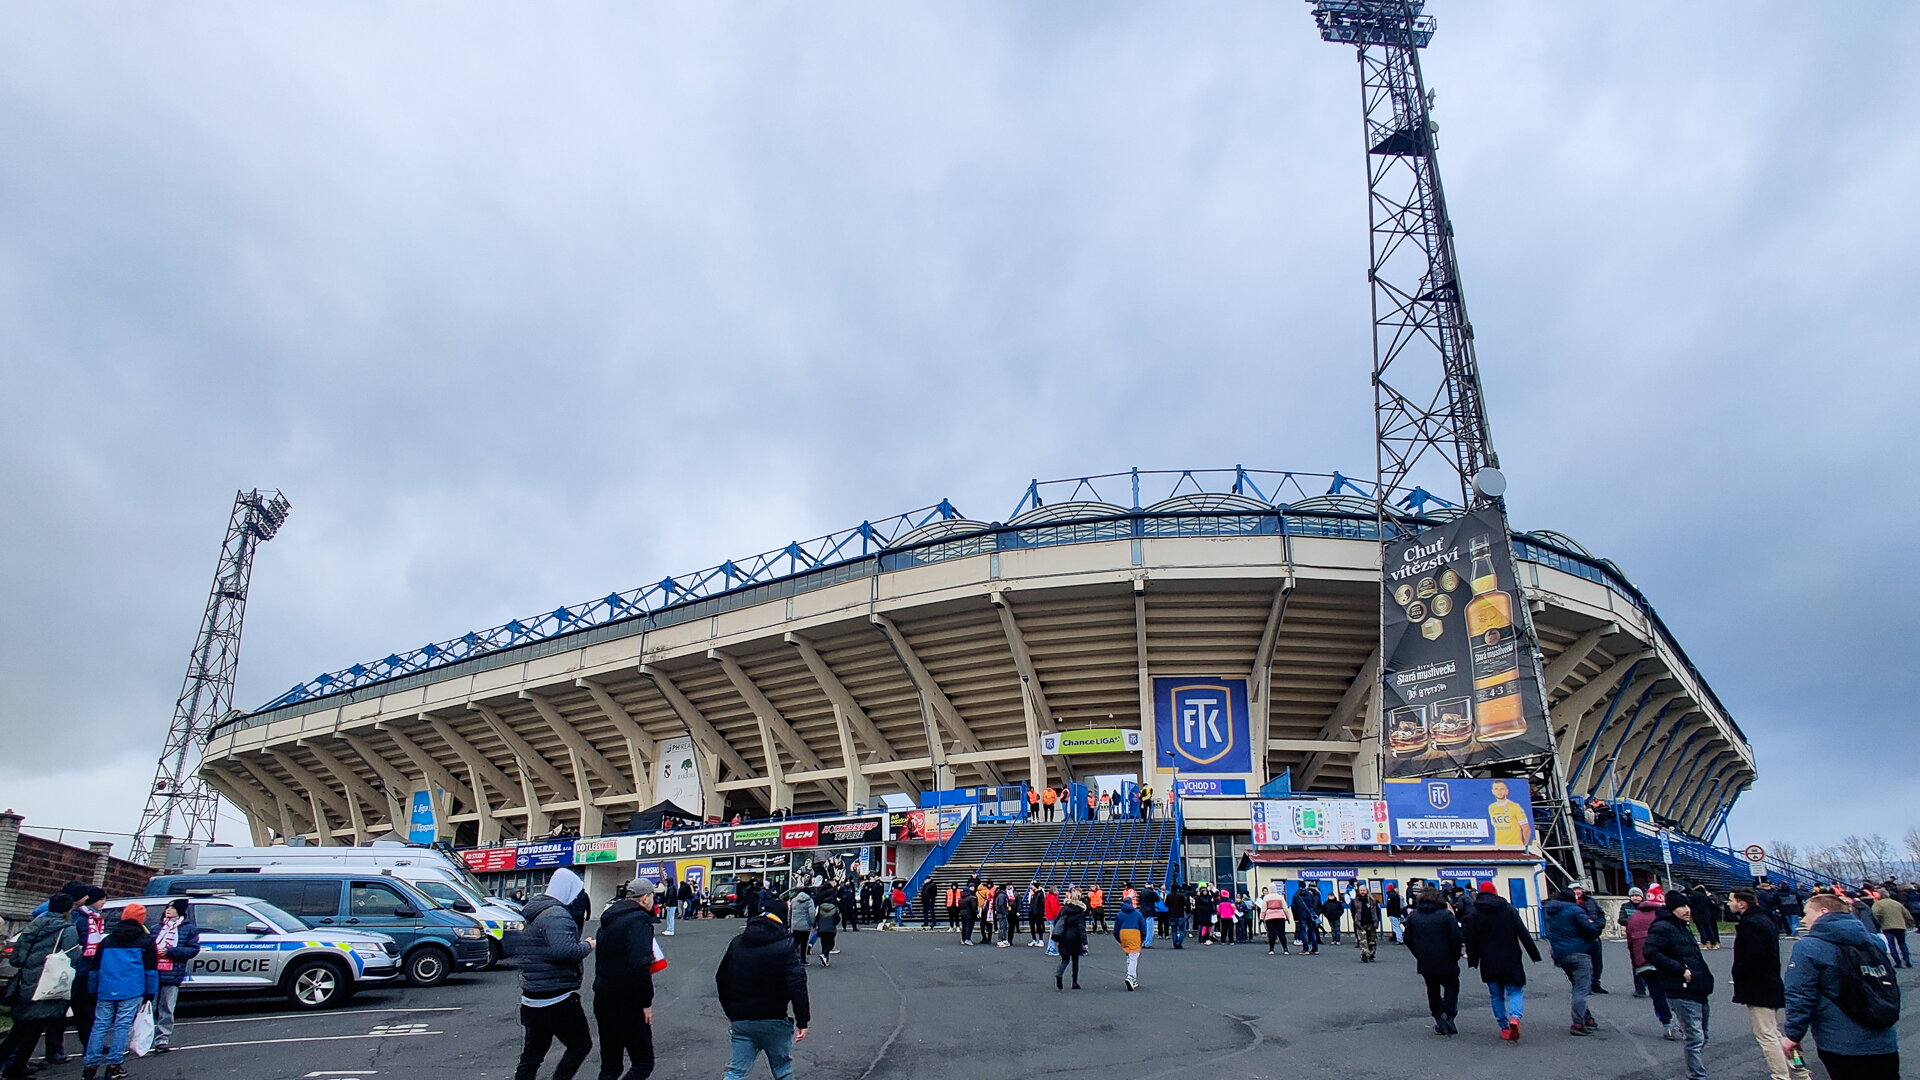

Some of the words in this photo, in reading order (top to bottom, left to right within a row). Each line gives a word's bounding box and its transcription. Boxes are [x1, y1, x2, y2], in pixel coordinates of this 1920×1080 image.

[1403, 537, 1445, 562] Chuť
[1390, 546, 1460, 581] vítězství
[1396, 672, 1416, 685] Stará
[1416, 662, 1456, 680] myslivecká
[1183, 781, 1209, 790] VCHOD
[1210, 781, 1217, 790] D
[1407, 821, 1418, 829] SK
[1419, 821, 1448, 829] SLAVIA
[1450, 821, 1478, 829] PRAHA
[784, 830, 815, 840] CCM
[517, 844, 562, 855] KOVOSREAL
[638, 832, 732, 856] FOTBAL-SPORT
[640, 866, 660, 875] FANSHO
[1332, 869, 1355, 877] DOMÁCÍ
[192, 959, 271, 973] POLICIE
